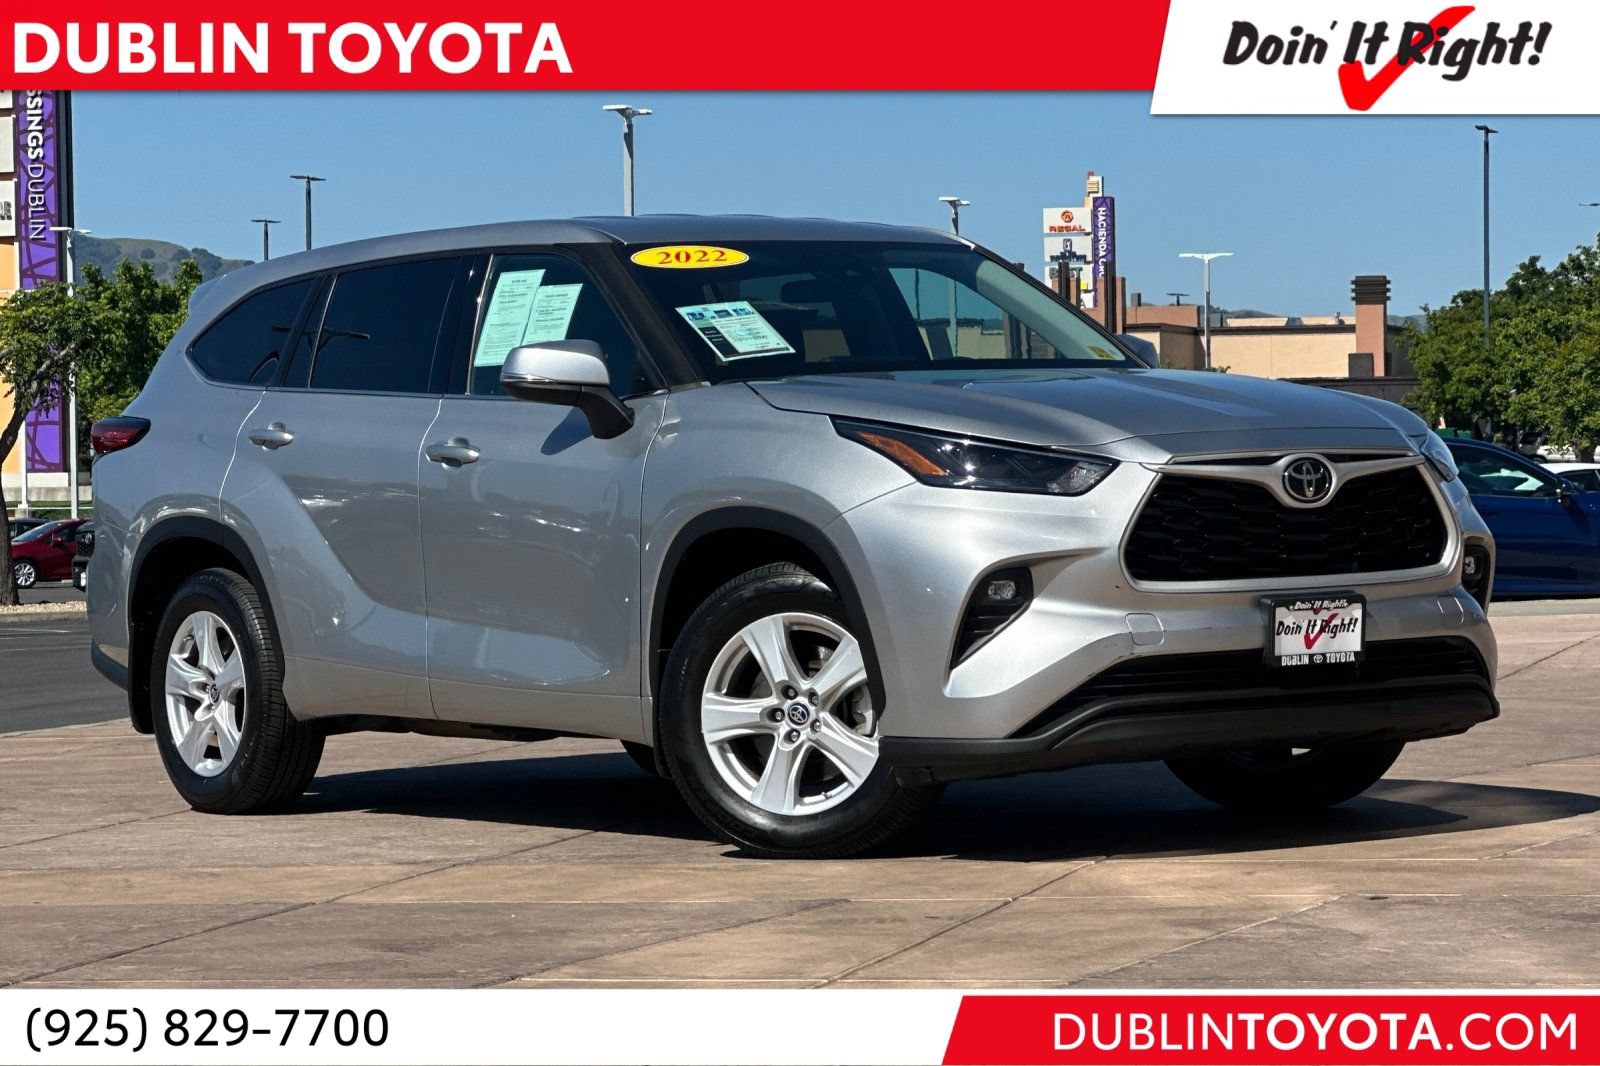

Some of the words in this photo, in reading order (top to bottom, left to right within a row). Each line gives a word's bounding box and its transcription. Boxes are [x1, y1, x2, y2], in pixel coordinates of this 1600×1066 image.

[28, 163, 45, 239] DUBLIN
[1049, 225, 1086, 233] REGAL
[1097, 207, 1107, 257] HACIENDA
[657, 250, 728, 264] 2022
[1306, 619, 1318, 634] It
[1321, 617, 1359, 639] Right!
[1281, 654, 1309, 666] DUBLIN
[1326, 652, 1355, 663] TOYOTA
